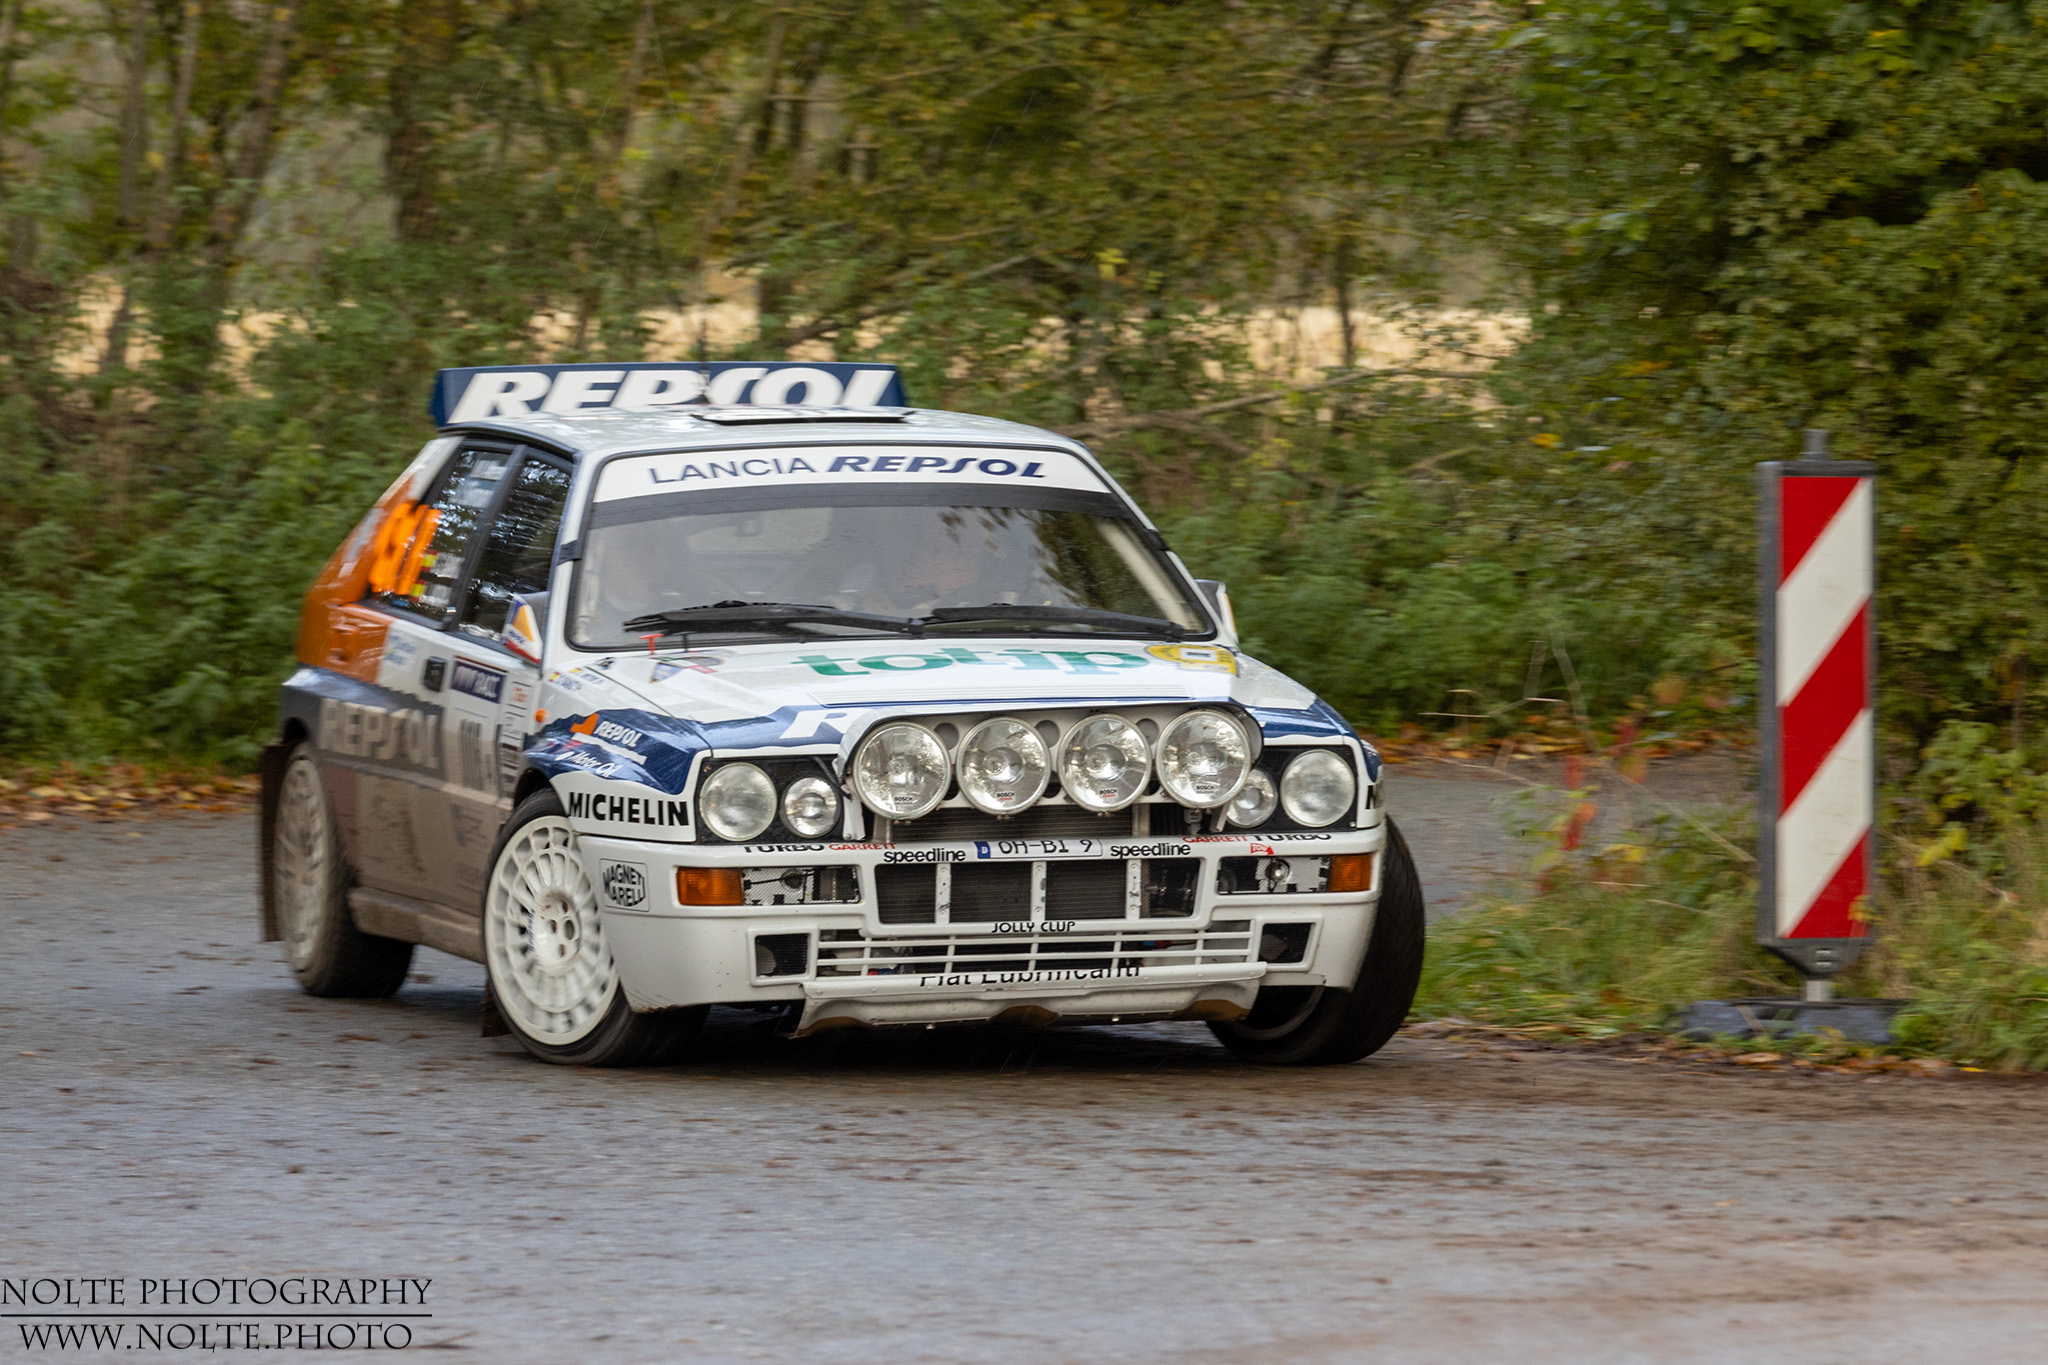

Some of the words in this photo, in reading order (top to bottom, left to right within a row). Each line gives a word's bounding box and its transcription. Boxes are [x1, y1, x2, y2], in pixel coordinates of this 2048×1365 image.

[649, 457, 818, 484] LANCIA
[827, 456, 1046, 478] REPSOL
[790, 647, 1151, 676] totip
[594, 721, 643, 747] REPSOL
[568, 751, 602, 769] Motor
[596, 762, 624, 778] Oil
[569, 792, 689, 826] MICHELIN
[828, 843, 897, 851] GARRETT
[1079, 839, 1093, 853] 9
[1182, 835, 1248, 843] GARRETT
[884, 848, 966, 864] speedline
[1110, 843, 1191, 859] speedline
[991, 922, 1035, 933] JOLLY
[1041, 920, 1076, 932] CLUP
